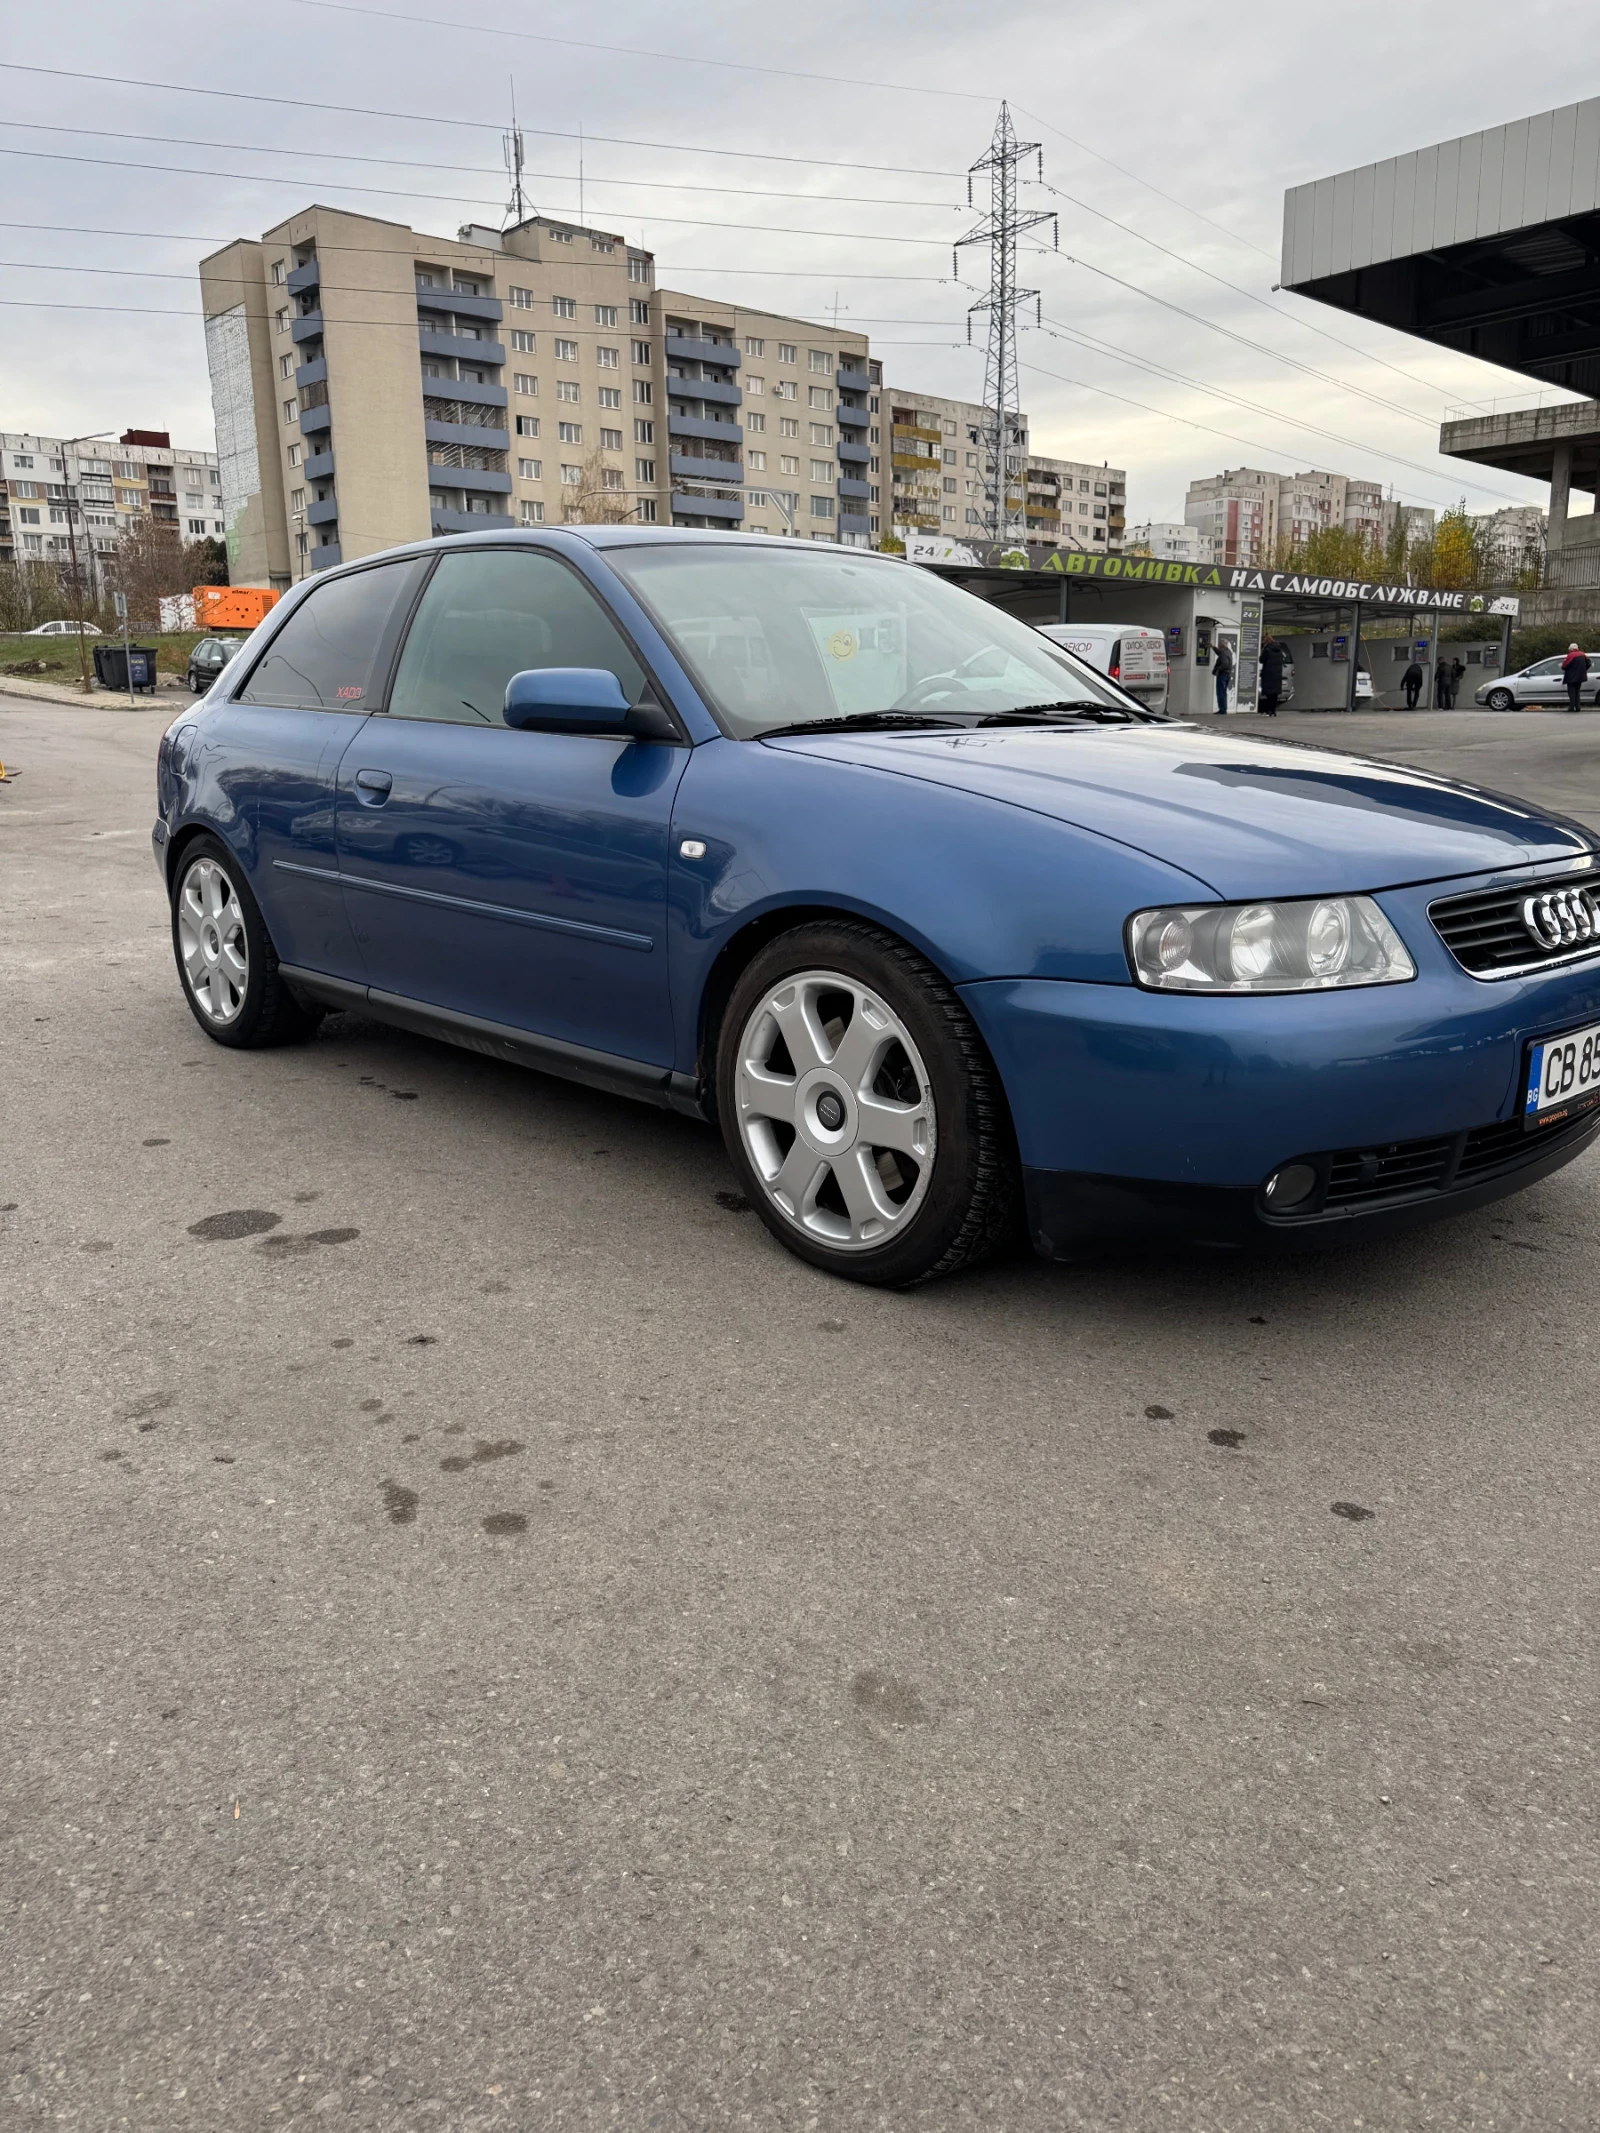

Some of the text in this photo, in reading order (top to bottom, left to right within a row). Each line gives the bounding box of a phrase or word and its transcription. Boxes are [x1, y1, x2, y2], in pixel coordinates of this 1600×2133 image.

[913, 545, 952, 557] 24/7
[1040, 552, 1221, 585] АВТОМИВКА
[1242, 611, 1260, 619] 24/7
[1545, 1042, 1577, 1098] CB
[1526, 1088, 1539, 1104] BG
